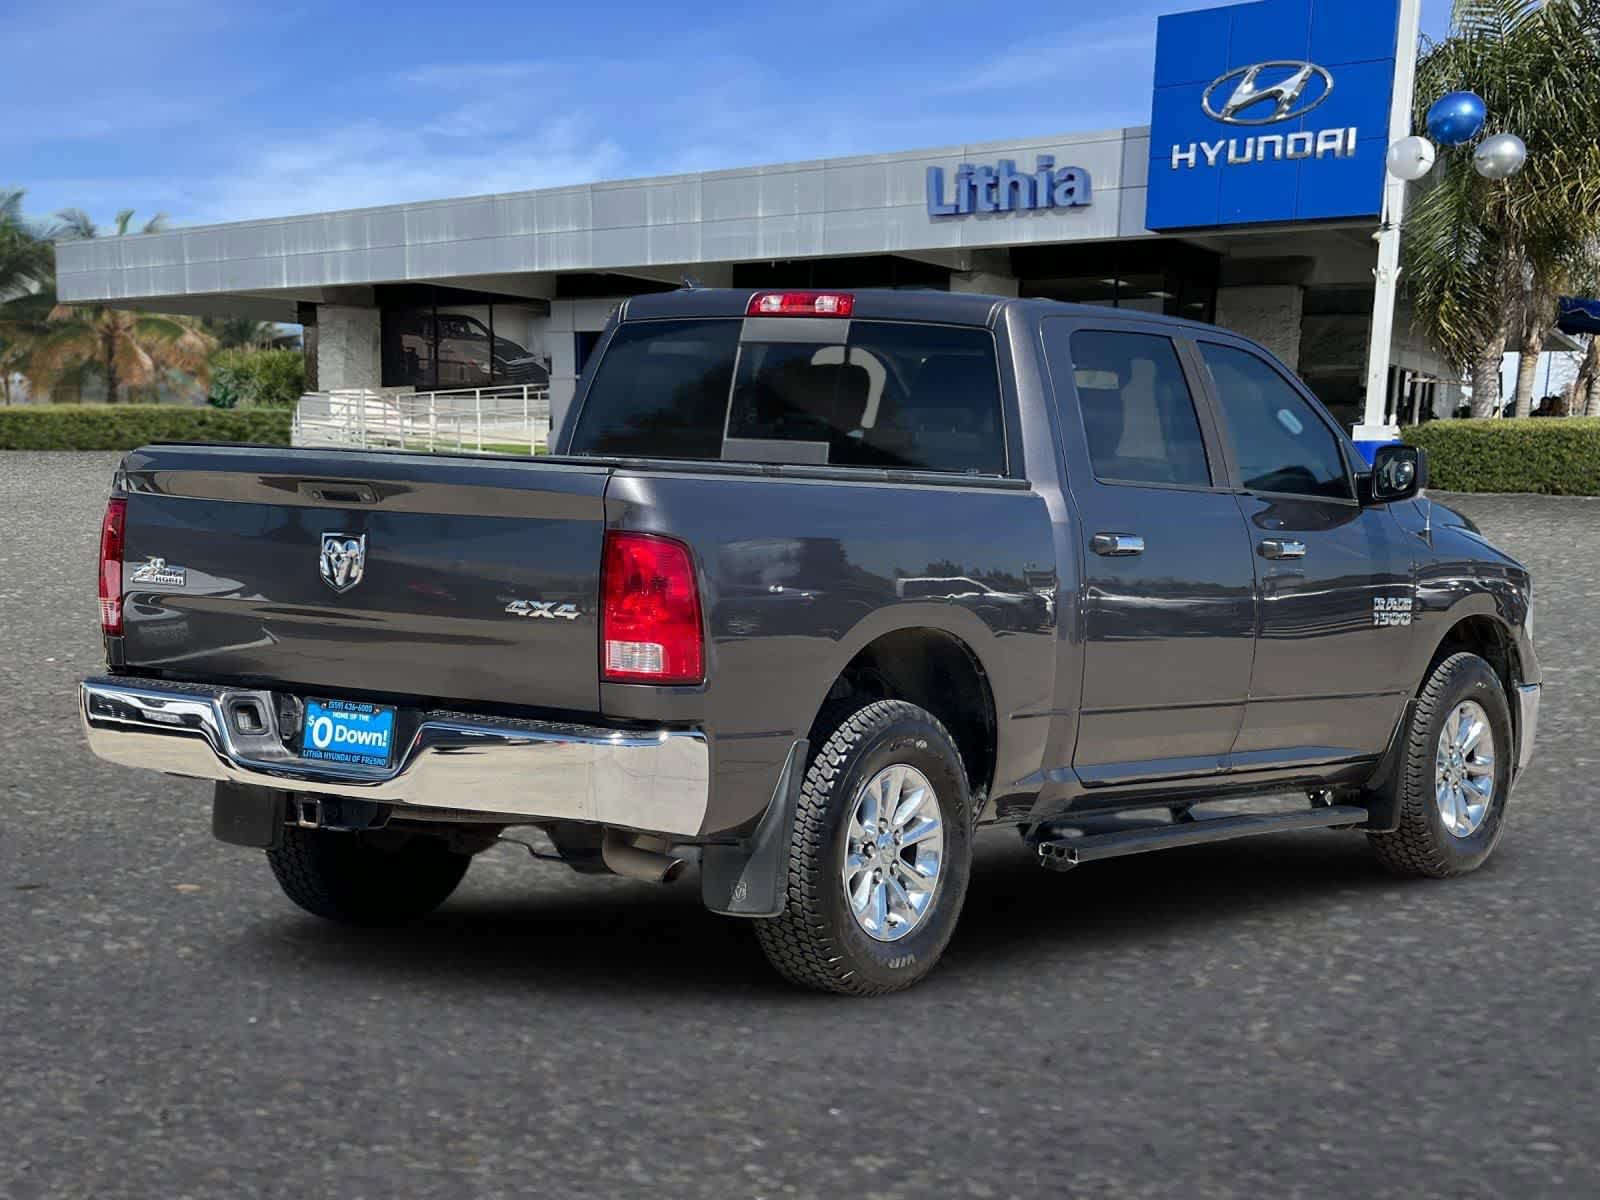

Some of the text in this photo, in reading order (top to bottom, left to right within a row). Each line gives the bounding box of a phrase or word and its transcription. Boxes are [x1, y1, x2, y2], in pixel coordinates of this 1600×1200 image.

[1171, 127, 1357, 169] HYUNDAI
[926, 154, 1092, 217] Lithia
[1373, 612, 1411, 626] 1500
[358, 714, 370, 722] THE
[334, 724, 388, 747] Down!
[303, 750, 386, 766] LITHIA HYUNDAI OF FRESNO
